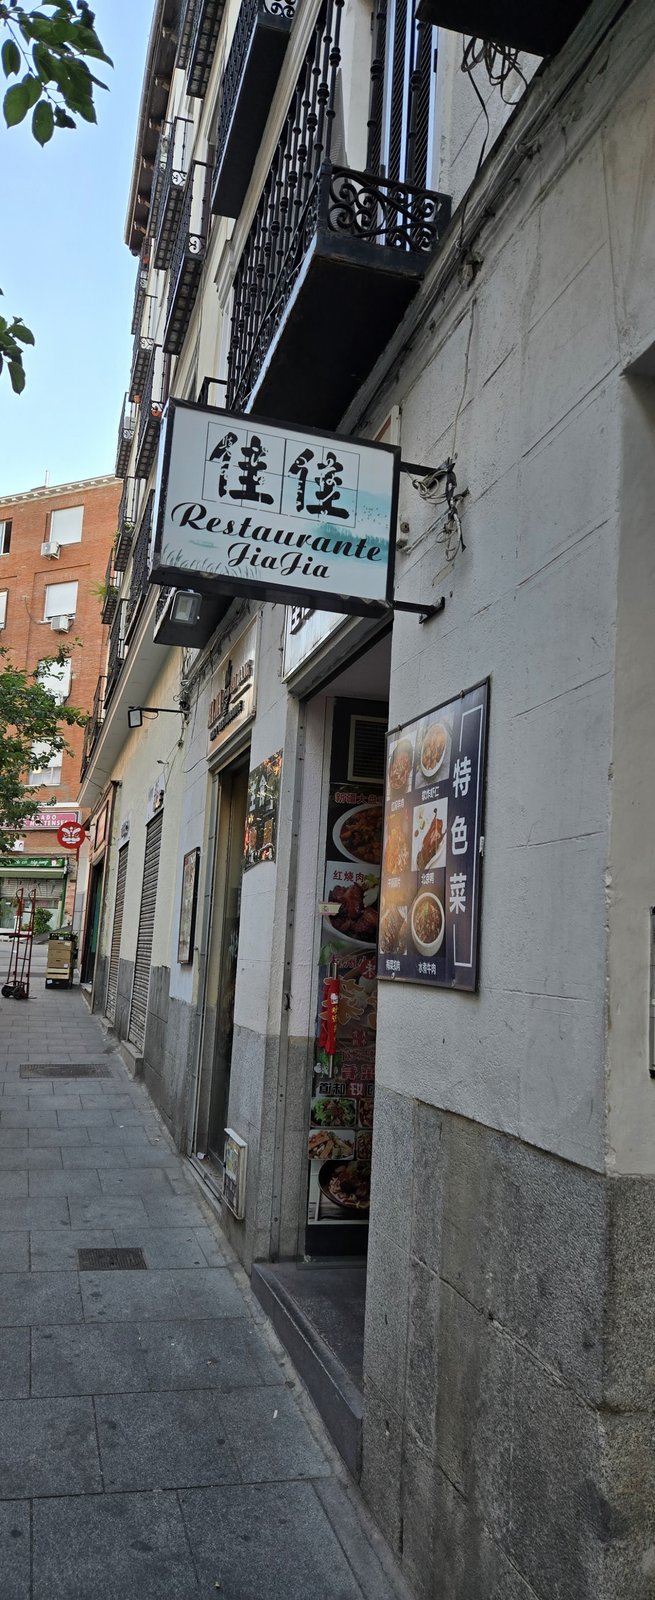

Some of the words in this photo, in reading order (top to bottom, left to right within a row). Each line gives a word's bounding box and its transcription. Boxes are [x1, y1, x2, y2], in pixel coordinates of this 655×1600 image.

[171, 502, 382, 562] Restaurante
[227, 542, 330, 579] JiaJia
[449, 755, 472, 915] 特色菜
[332, 870, 365, 883] 红烧肉
